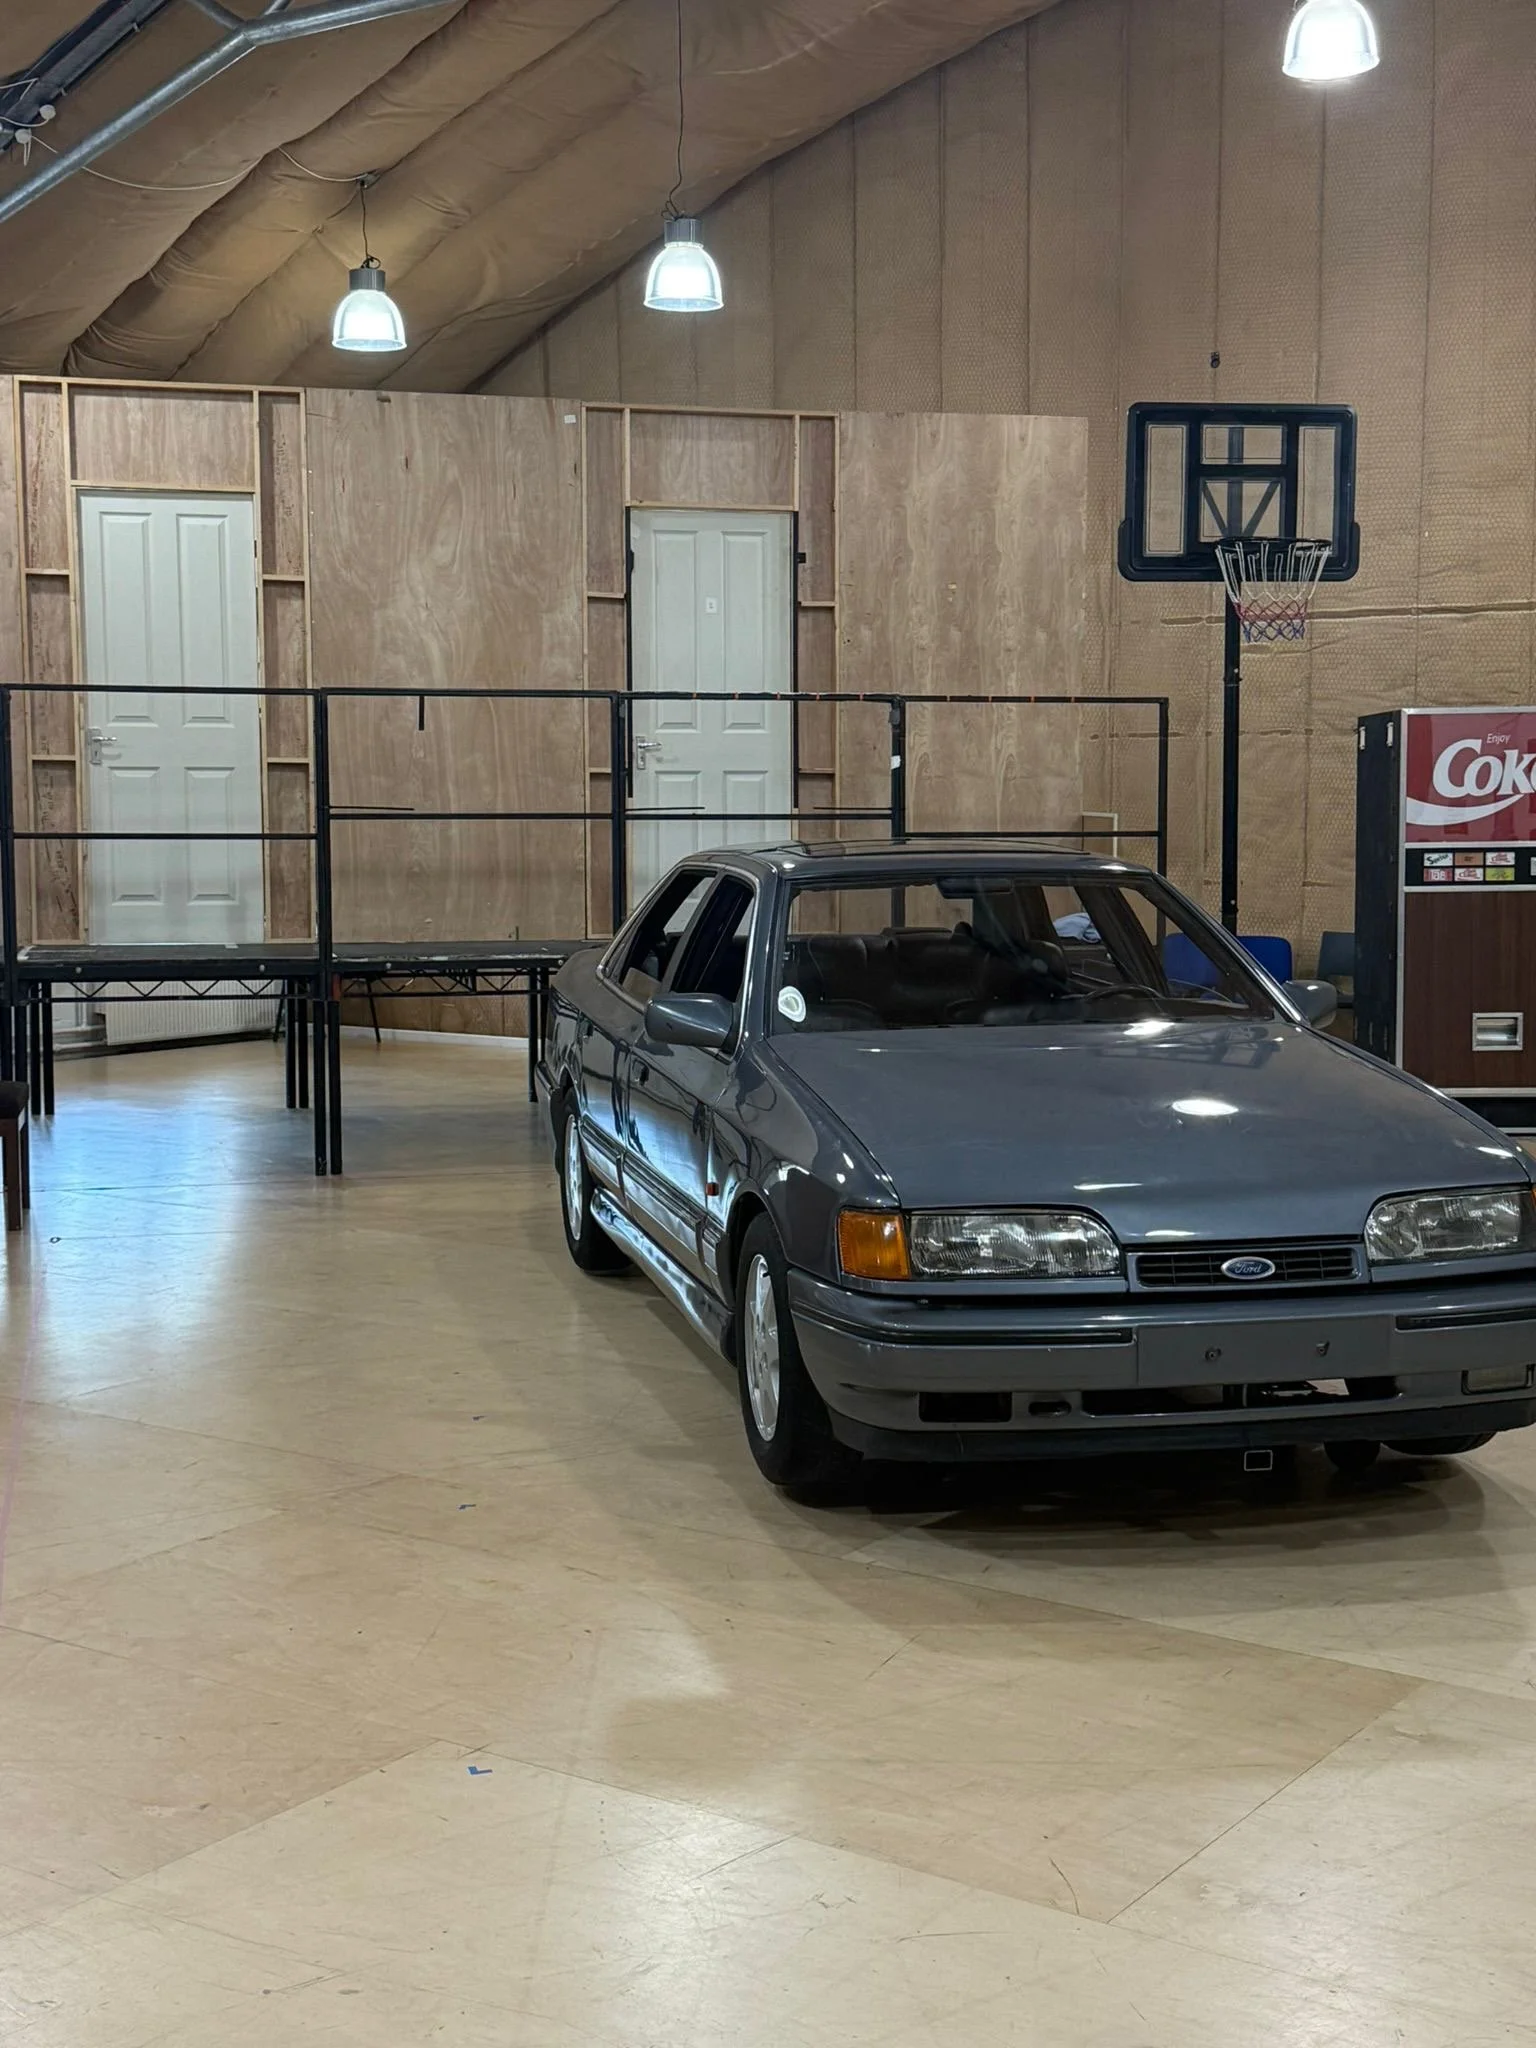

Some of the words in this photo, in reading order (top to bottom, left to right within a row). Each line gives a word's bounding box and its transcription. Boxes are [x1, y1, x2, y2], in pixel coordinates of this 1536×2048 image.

[1486, 733, 1511, 745] Enjoy
[1432, 739, 1536, 798] Cok
[1234, 1261, 1263, 1274] Ford
